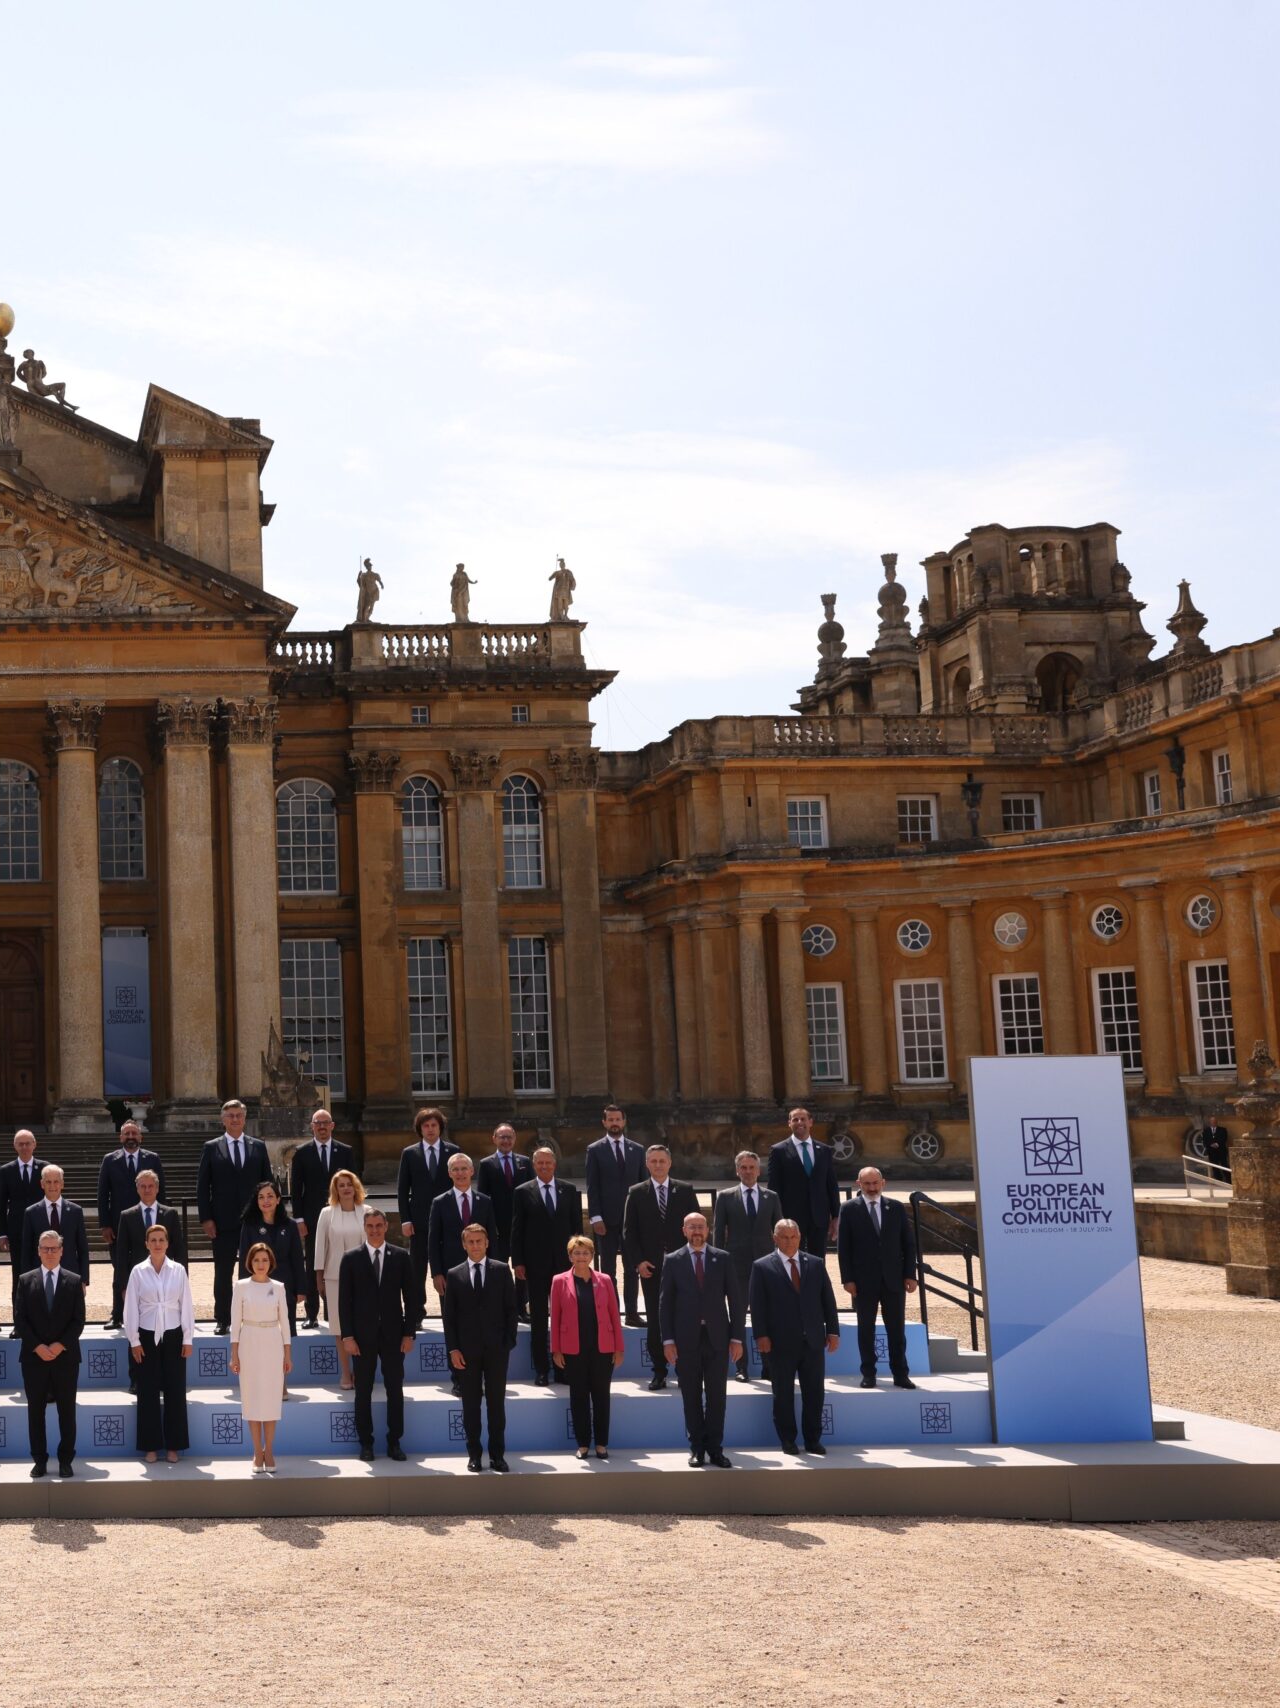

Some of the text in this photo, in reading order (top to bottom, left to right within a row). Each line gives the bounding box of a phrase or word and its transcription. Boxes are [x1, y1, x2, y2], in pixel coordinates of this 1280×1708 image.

[1006, 1182, 1105, 1197] EUROPEAN
[1011, 1197, 1102, 1211] POLITICAL
[1002, 1210, 1113, 1225] COMMUNITY
